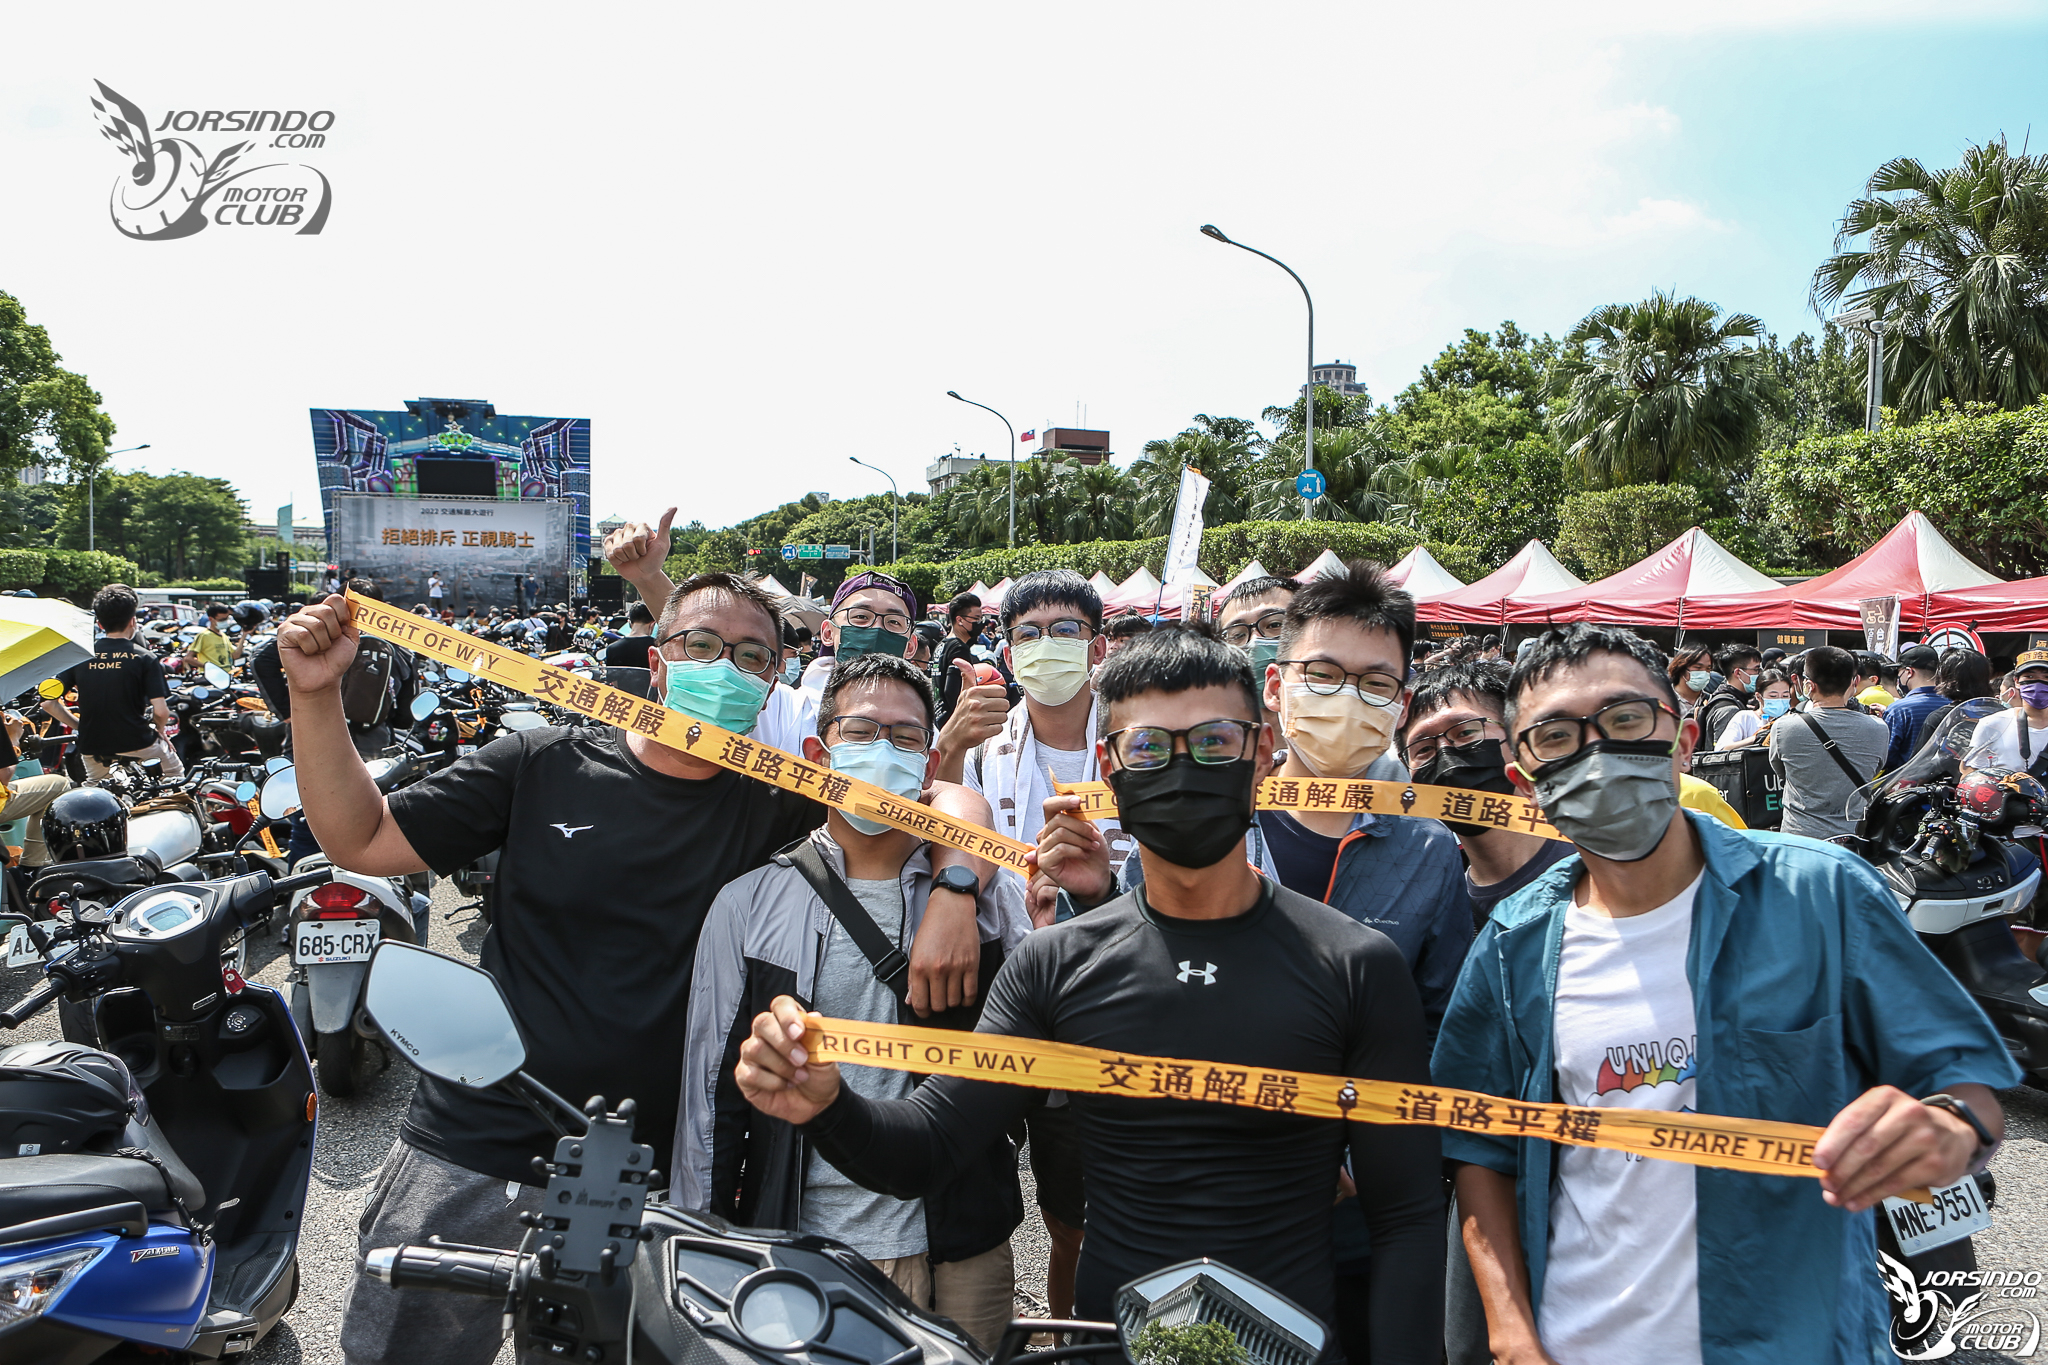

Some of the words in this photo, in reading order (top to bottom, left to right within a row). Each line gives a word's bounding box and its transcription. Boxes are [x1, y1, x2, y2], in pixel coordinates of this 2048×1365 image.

[420, 507, 439, 515] 2022
[381, 527, 457, 547] 拒絕排斥
[461, 529, 536, 549] 正視騎士
[112, 652, 139, 660] WAY
[354, 603, 420, 641] RIGHT
[423, 632, 453, 652] OF
[455, 643, 501, 670] WAY
[88, 661, 122, 670] HOME
[533, 667, 667, 738] 交通解嚴
[718, 735, 853, 806] 道路平權
[876, 800, 939, 834] SHARE
[941, 824, 980, 850] THE
[978, 838, 1030, 869] ROAD
[1440, 789, 1563, 838] 道路平
[389, 1028, 420, 1056] KYMCO
[822, 1033, 913, 1061] RIGHT
[924, 1045, 963, 1066] OF
[972, 1050, 1037, 1075] WAY
[1099, 1057, 1300, 1114] 交通解嚴
[1394, 1088, 1603, 1143] 道路平權
[1649, 1127, 1748, 1158] SHARE
[1757, 1139, 1815, 1166] THE
